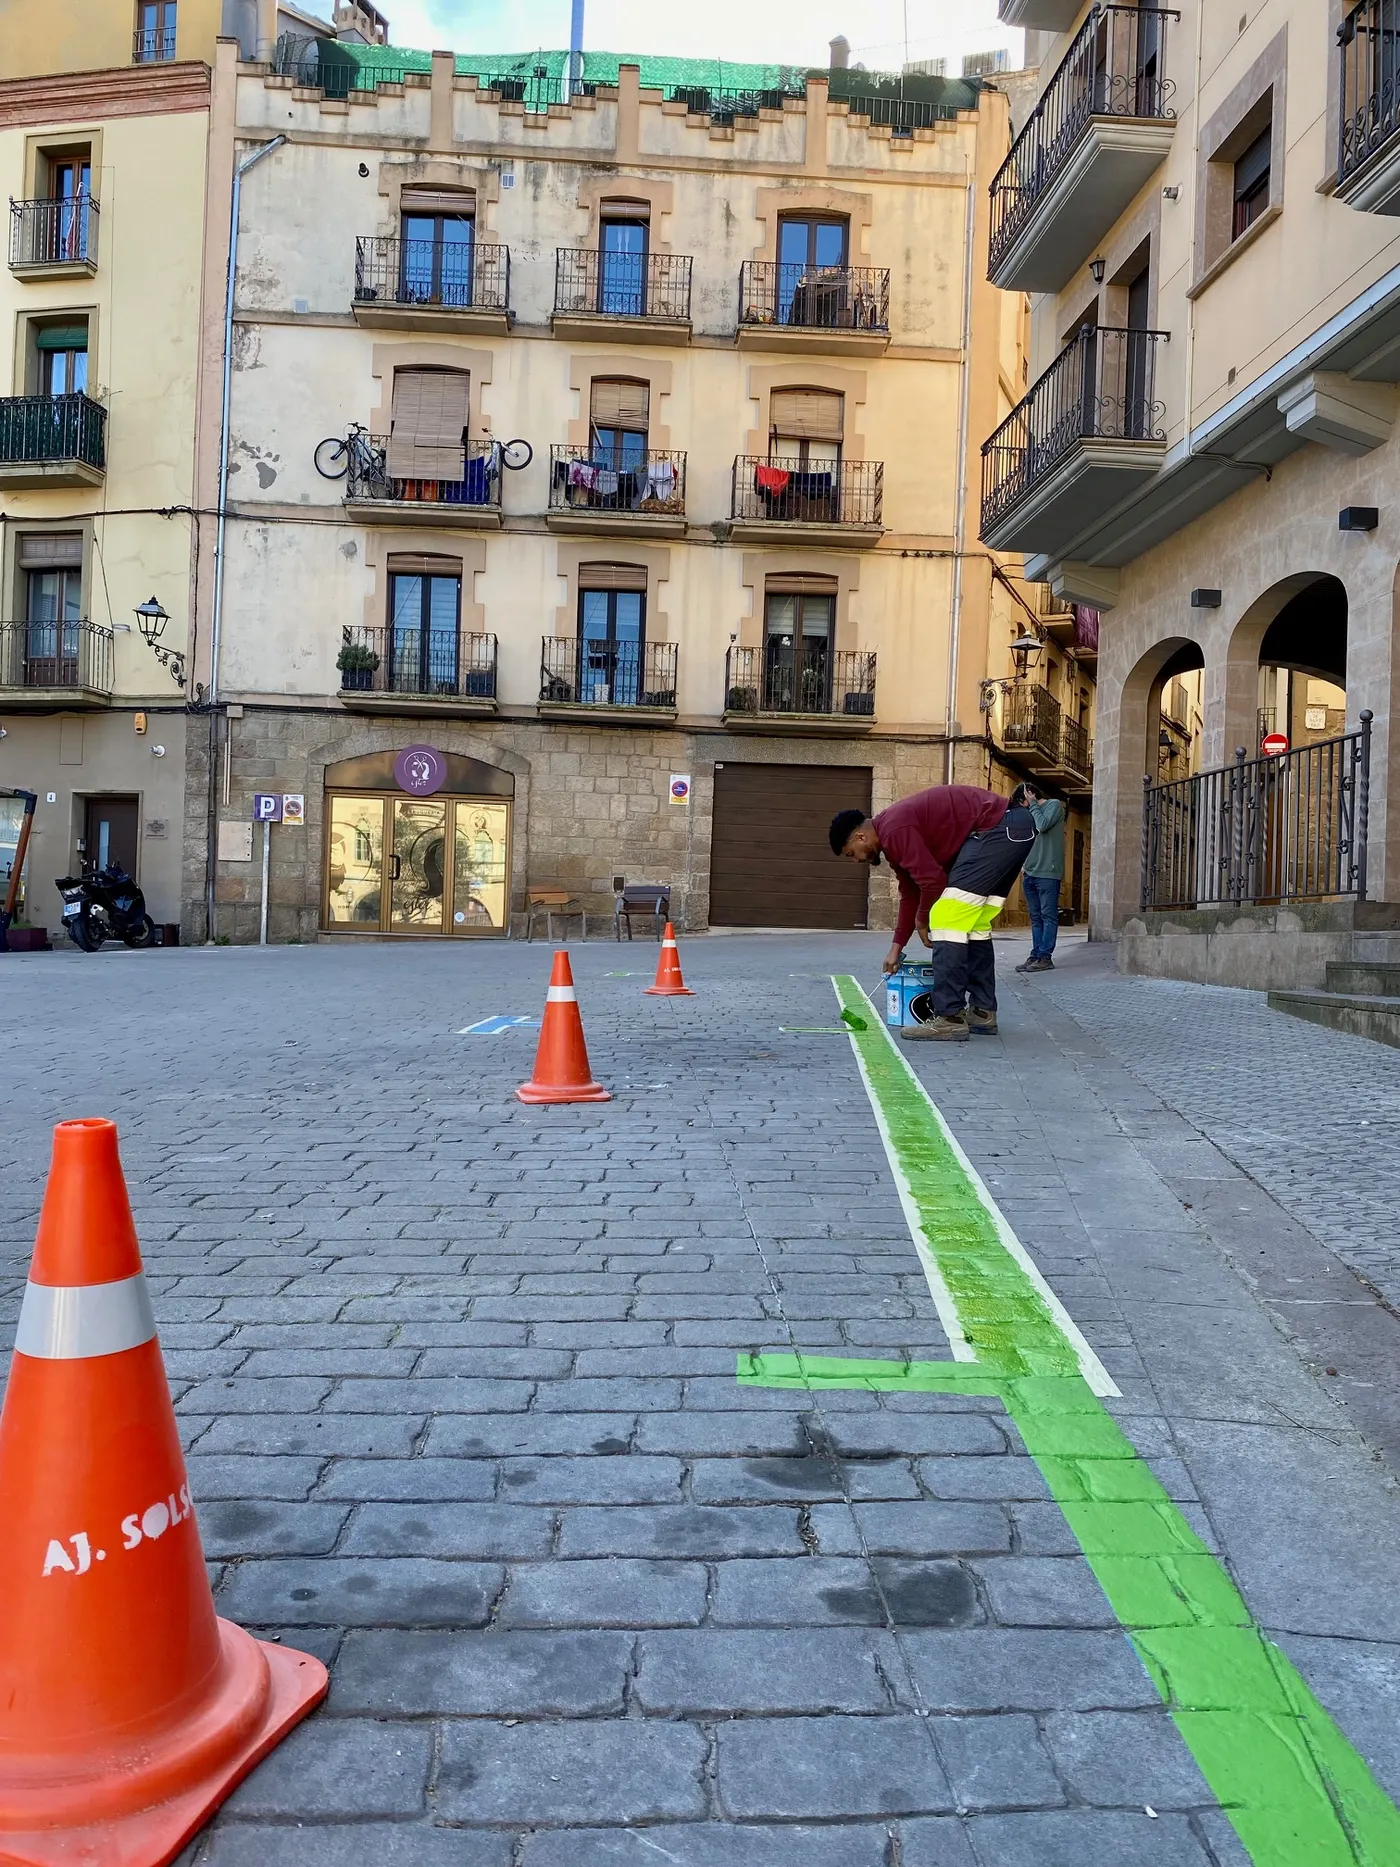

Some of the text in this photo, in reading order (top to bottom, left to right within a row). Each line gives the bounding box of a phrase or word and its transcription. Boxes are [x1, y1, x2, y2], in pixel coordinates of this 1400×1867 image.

[260, 796, 275, 818] P
[42, 1483, 193, 1578] AJ. SOLS
